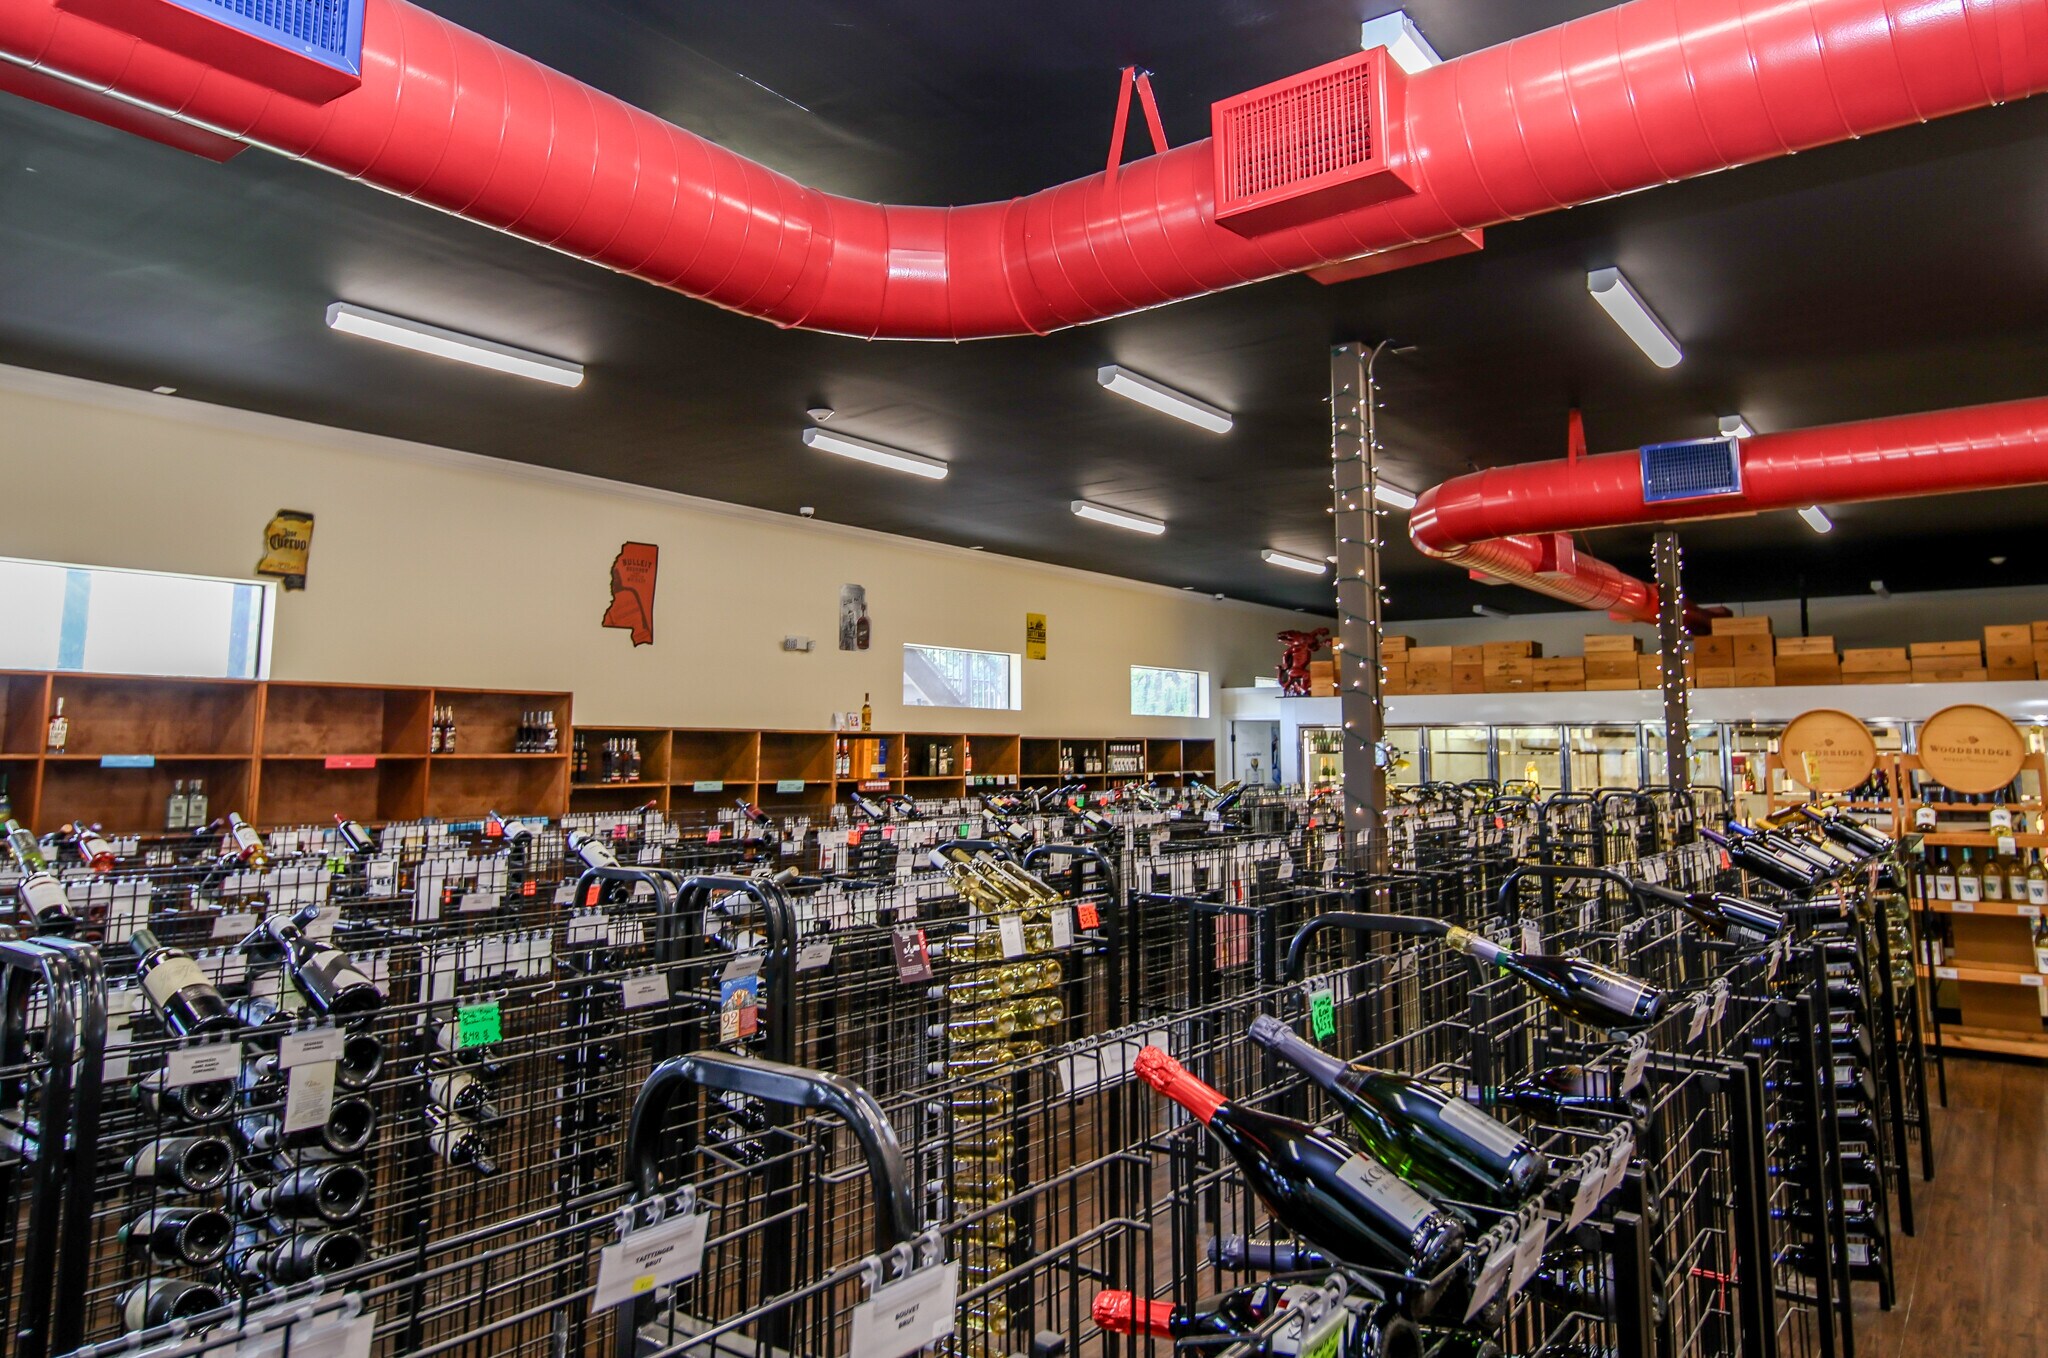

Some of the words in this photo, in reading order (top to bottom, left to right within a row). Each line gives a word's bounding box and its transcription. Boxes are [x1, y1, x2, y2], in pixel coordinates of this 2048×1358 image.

[270, 534, 306, 550] Cuervo
[1791, 749, 1864, 757] WDBRIDGE
[1930, 745, 2012, 756] WOODBRIDGE
[722, 1011, 738, 1030] 92
[644, 1257, 662, 1269] BRUT
[895, 1303, 920, 1320] BOUVET
[898, 1315, 915, 1329] BRUT
